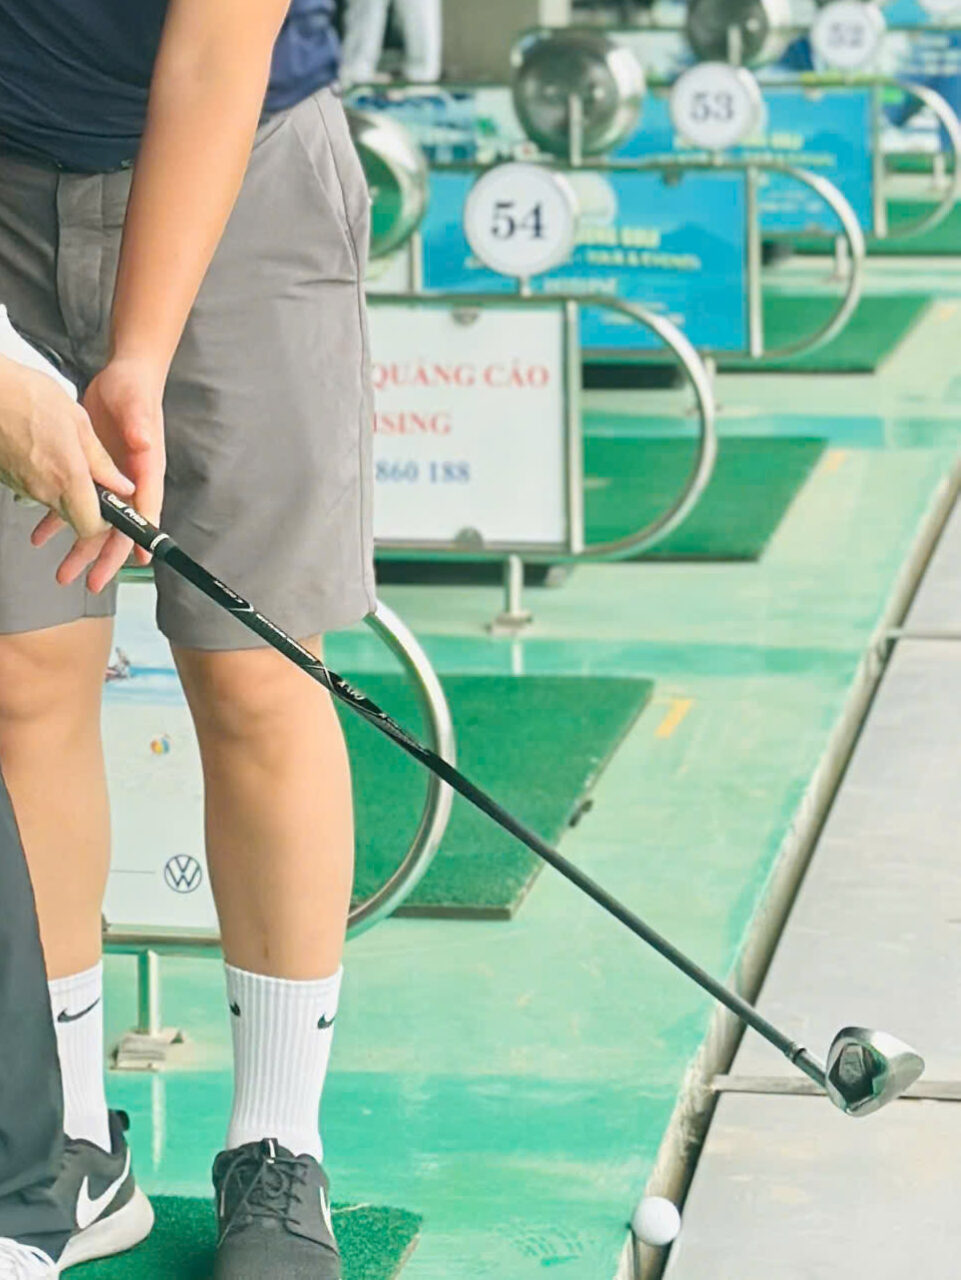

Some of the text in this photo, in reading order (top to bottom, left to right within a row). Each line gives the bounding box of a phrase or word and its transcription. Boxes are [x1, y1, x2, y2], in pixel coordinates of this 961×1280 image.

[690, 92, 736, 122] 53
[491, 201, 545, 240] 54
[428, 460, 471, 484] 188
